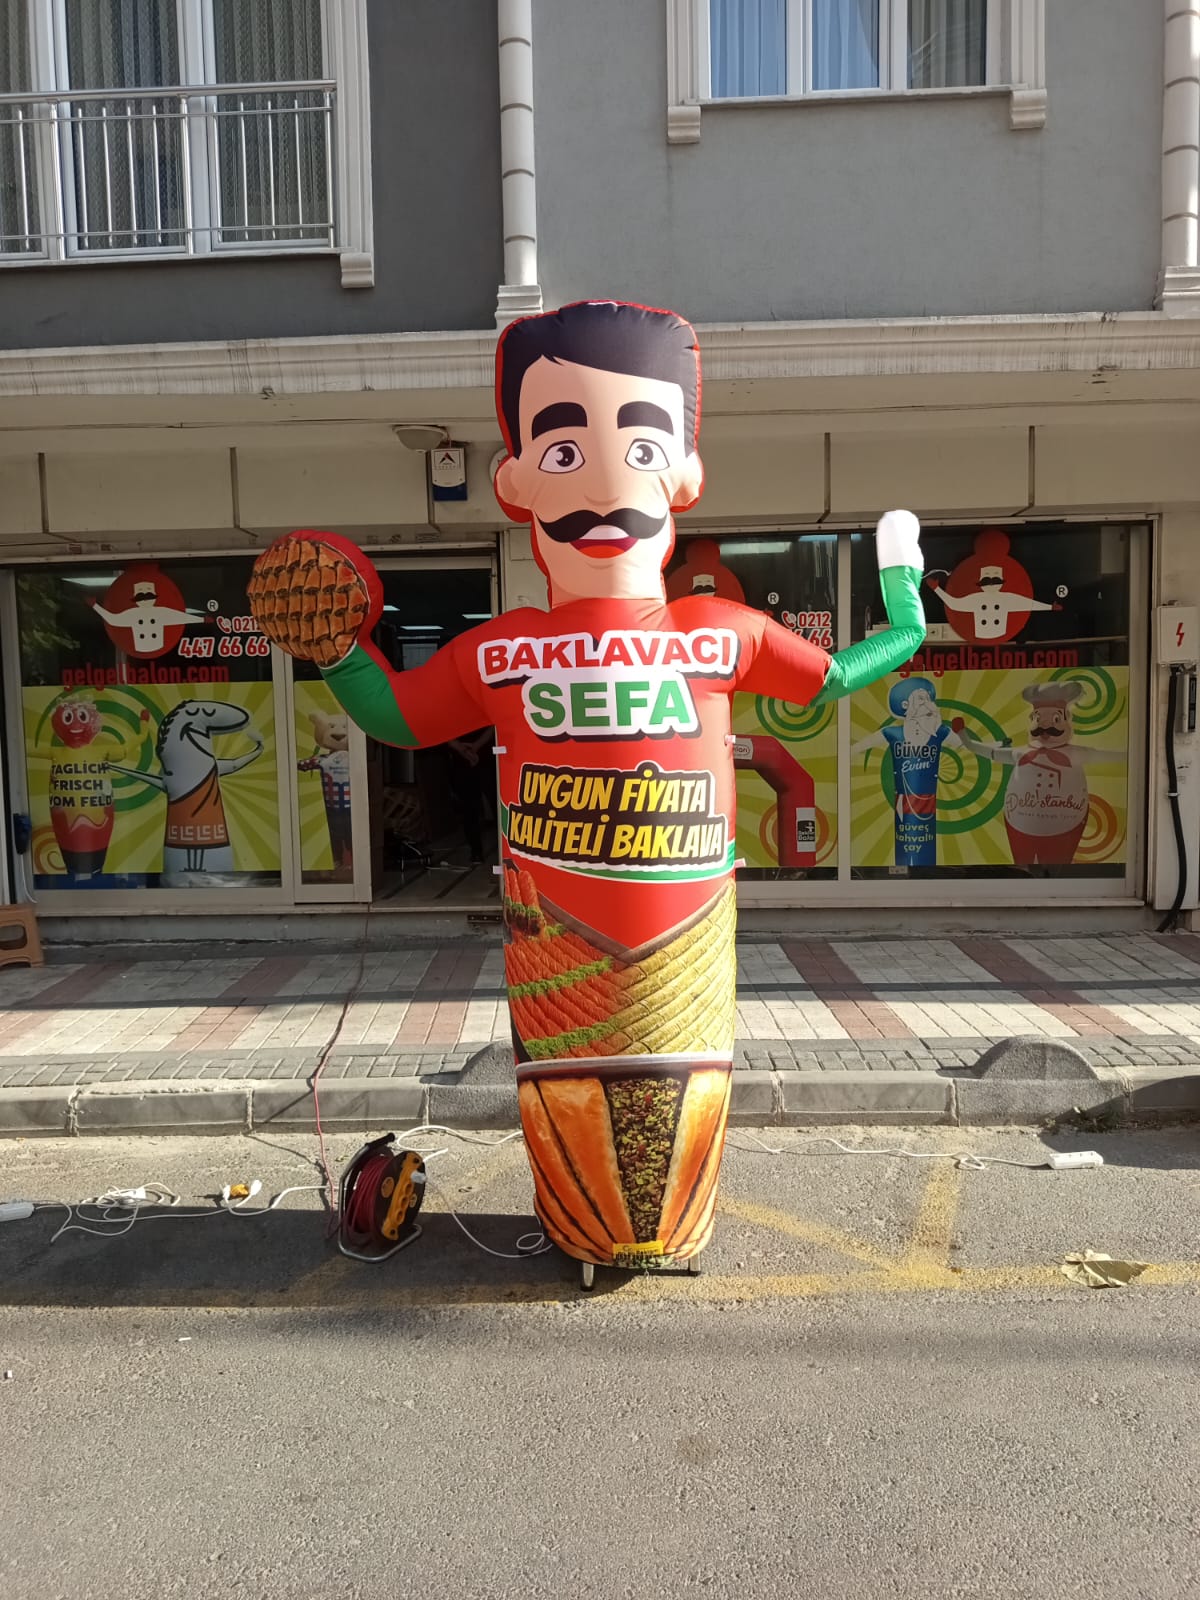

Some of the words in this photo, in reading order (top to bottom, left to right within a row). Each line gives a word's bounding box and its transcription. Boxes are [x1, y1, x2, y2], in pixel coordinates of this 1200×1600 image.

[797, 611, 832, 629] 0212
[178, 637, 215, 658] 447
[218, 637, 243, 657] 66
[245, 636, 270, 656] 66
[484, 635, 730, 676] BAKLAVACI
[63, 661, 229, 691] gelgelbalon.com
[528, 680, 690, 728] SEFA
[894, 740, 938, 763] Güveç
[901, 758, 931, 773] Evim
[53, 779, 103, 791] FRISCH
[523, 770, 615, 810] UYGUN
[620, 771, 707, 812] FİYATA
[80, 795, 112, 807] FELD
[510, 810, 609, 856] KALİTELİ
[610, 821, 723, 859] BAKLAVA
